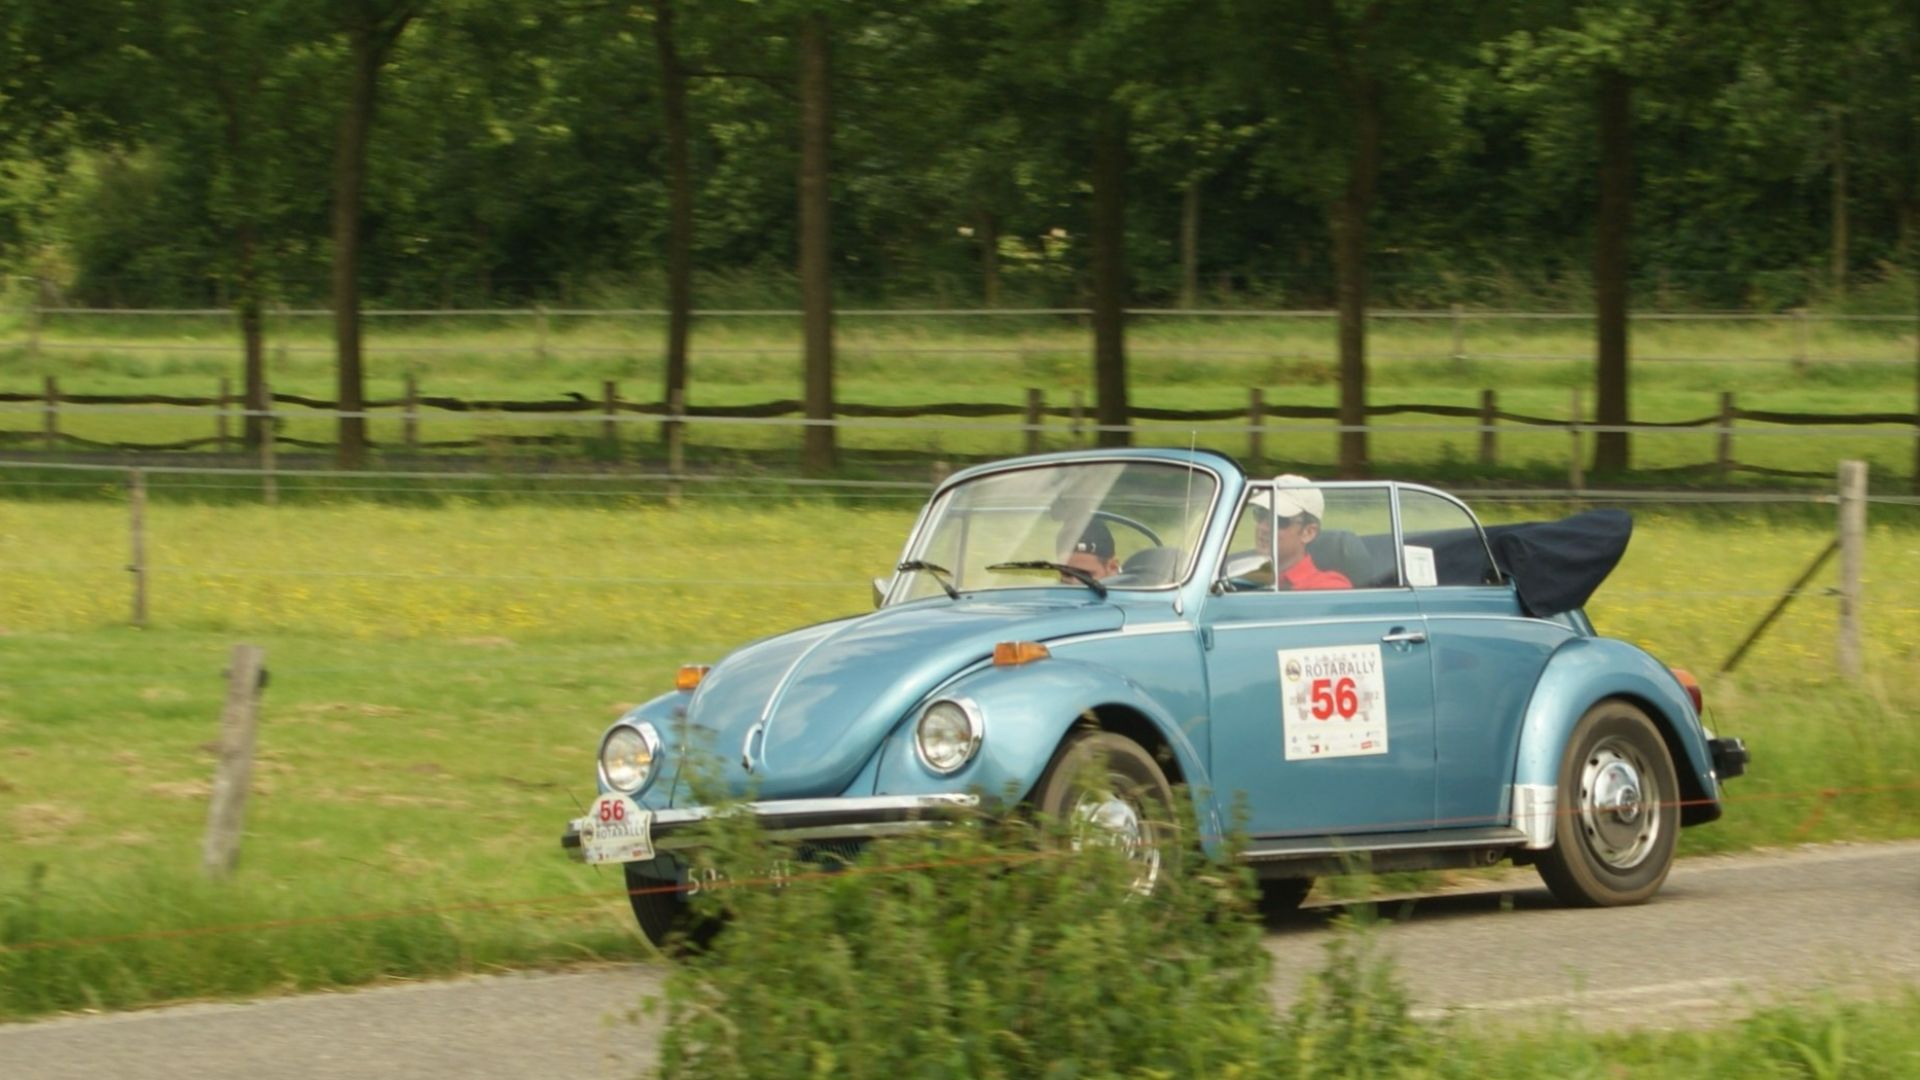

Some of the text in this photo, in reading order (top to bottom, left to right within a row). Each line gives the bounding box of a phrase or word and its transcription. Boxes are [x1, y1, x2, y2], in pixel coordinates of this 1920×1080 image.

[1305, 660, 1376, 677] ROTARALLY
[1312, 677, 1357, 719] 56
[600, 799, 625, 822] 56
